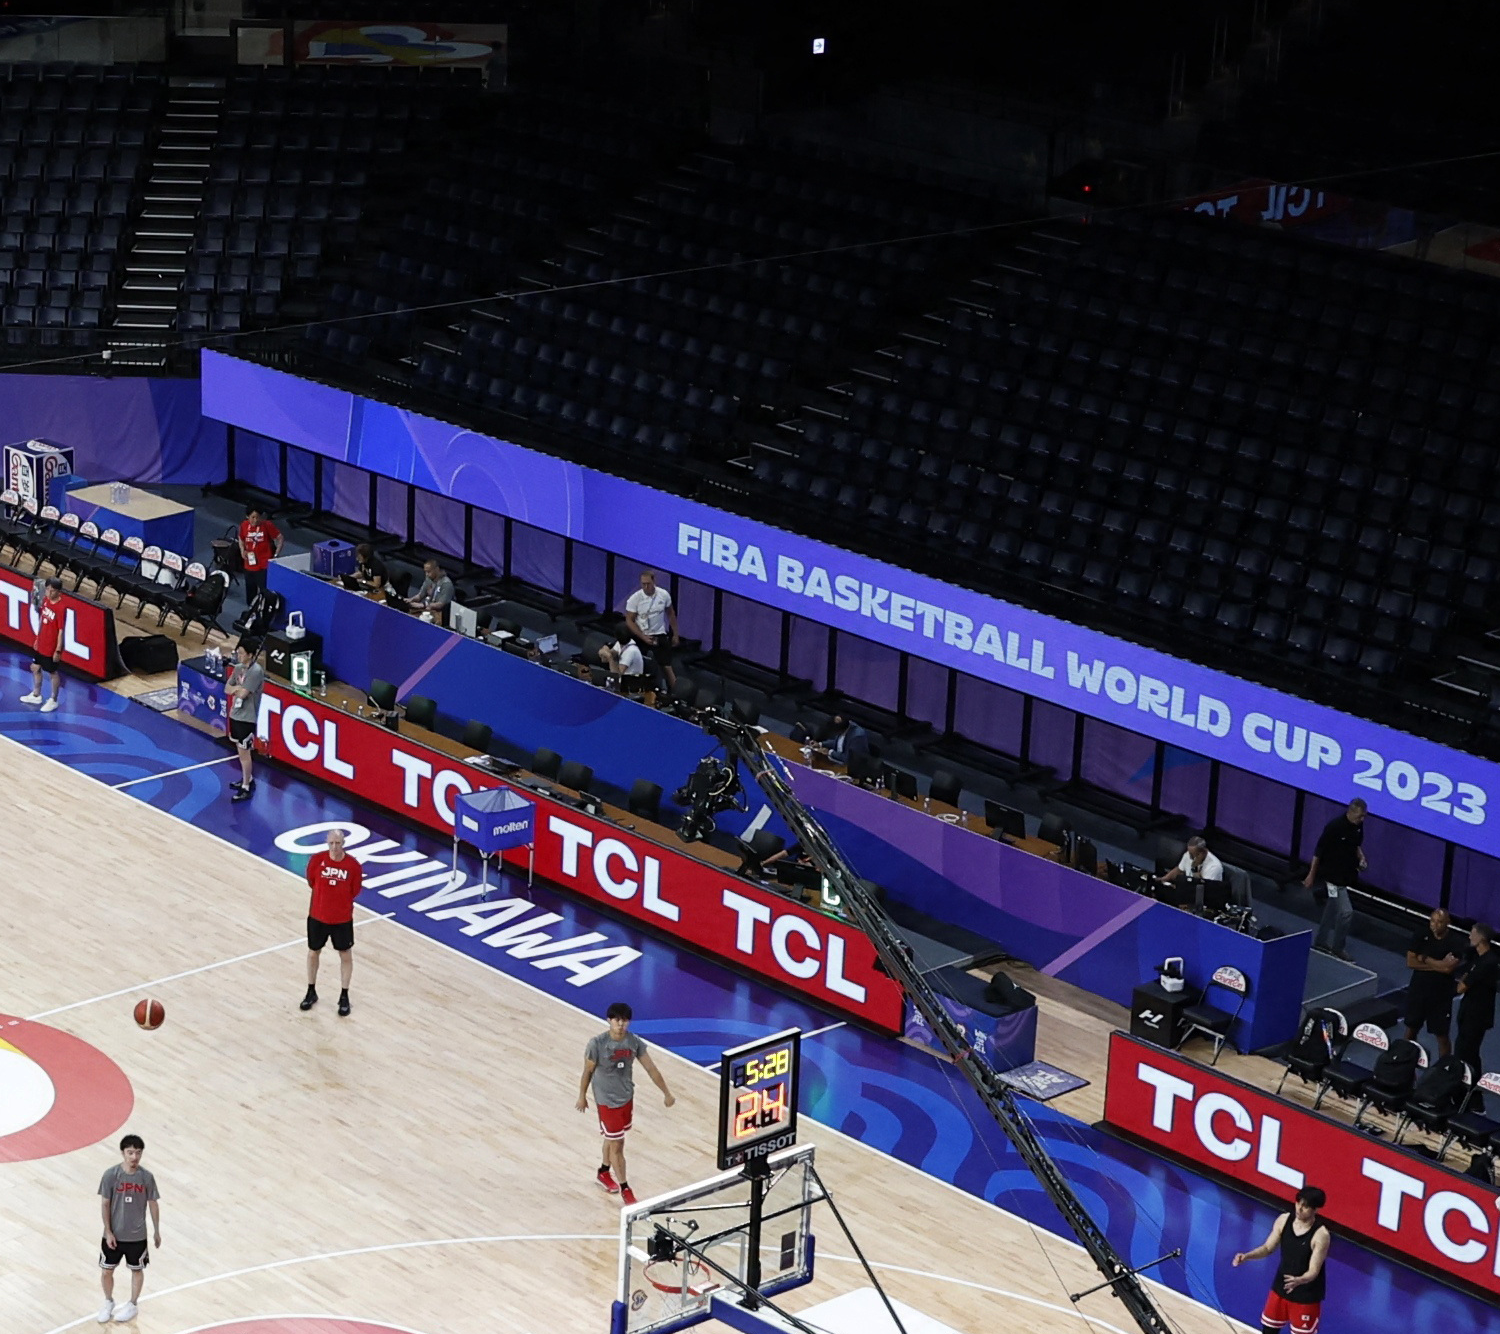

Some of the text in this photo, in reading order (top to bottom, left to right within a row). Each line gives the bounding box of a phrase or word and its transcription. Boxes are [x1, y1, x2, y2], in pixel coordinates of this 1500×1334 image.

[678, 523, 1486, 824] FIBA BASKETBALL WORLD CUP 2023
[257, 691, 865, 1003] TCL TCL TCL
[493, 821, 528, 836] molten
[321, 866, 348, 880] JPN
[746, 1050, 790, 1087] 5:28
[734, 1082, 787, 1139] 24
[1138, 1059, 1309, 1189] TCL
[746, 1133, 796, 1163] TISSOT
[116, 1181, 145, 1194] JPN
